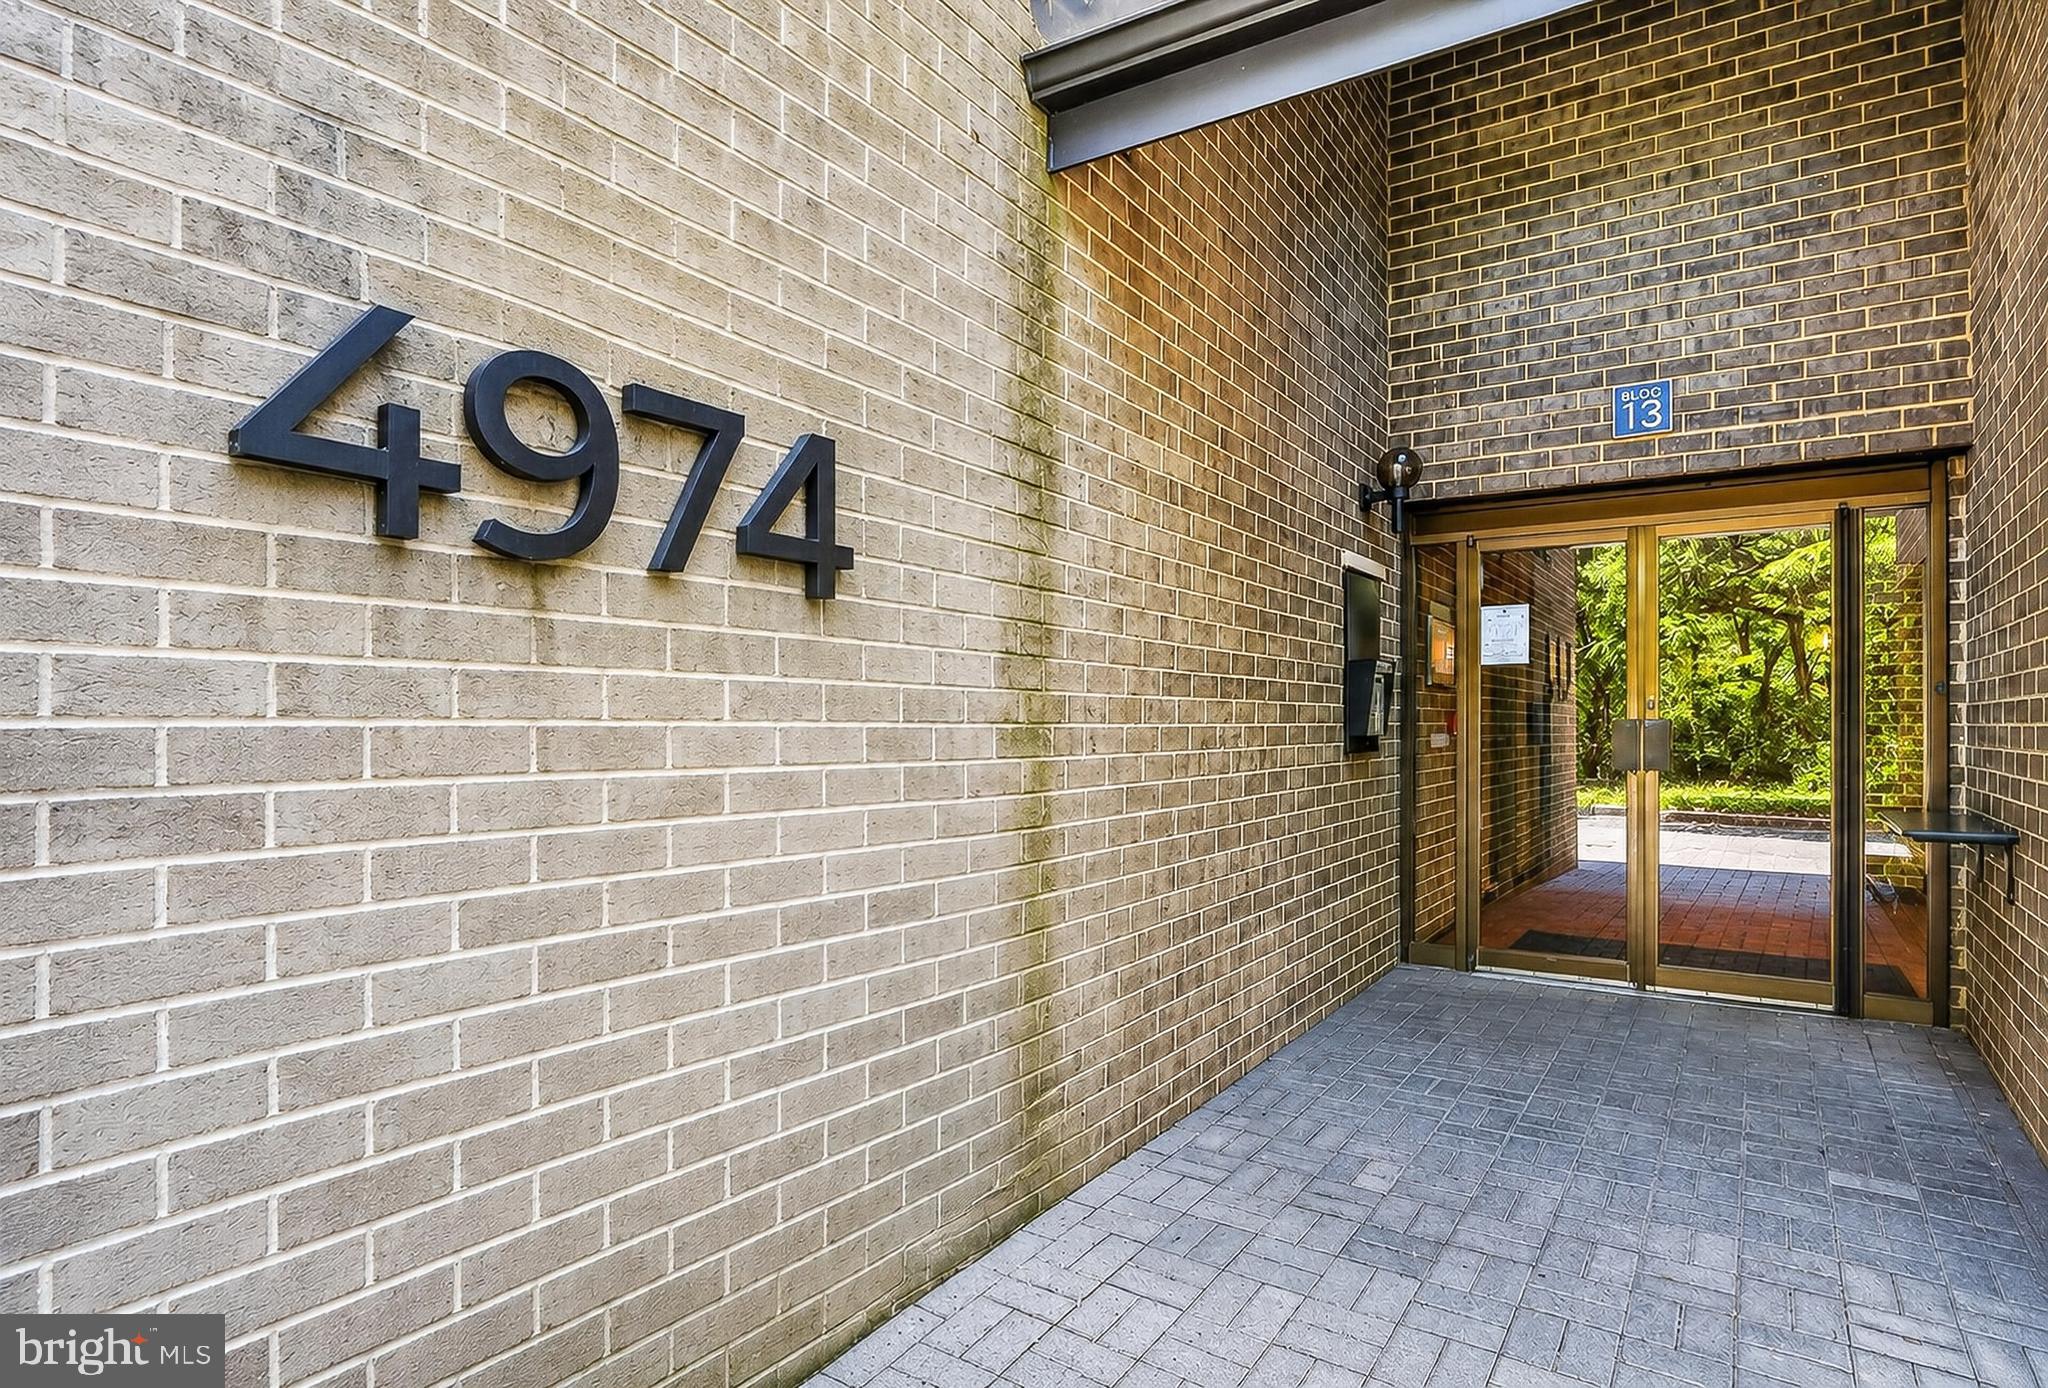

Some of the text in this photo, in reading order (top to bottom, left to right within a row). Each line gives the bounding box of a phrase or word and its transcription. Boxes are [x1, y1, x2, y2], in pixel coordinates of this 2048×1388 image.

[1621, 386, 1662, 402] BLOC
[1622, 399, 1663, 430] 13
[228, 303, 854, 600] 4974
